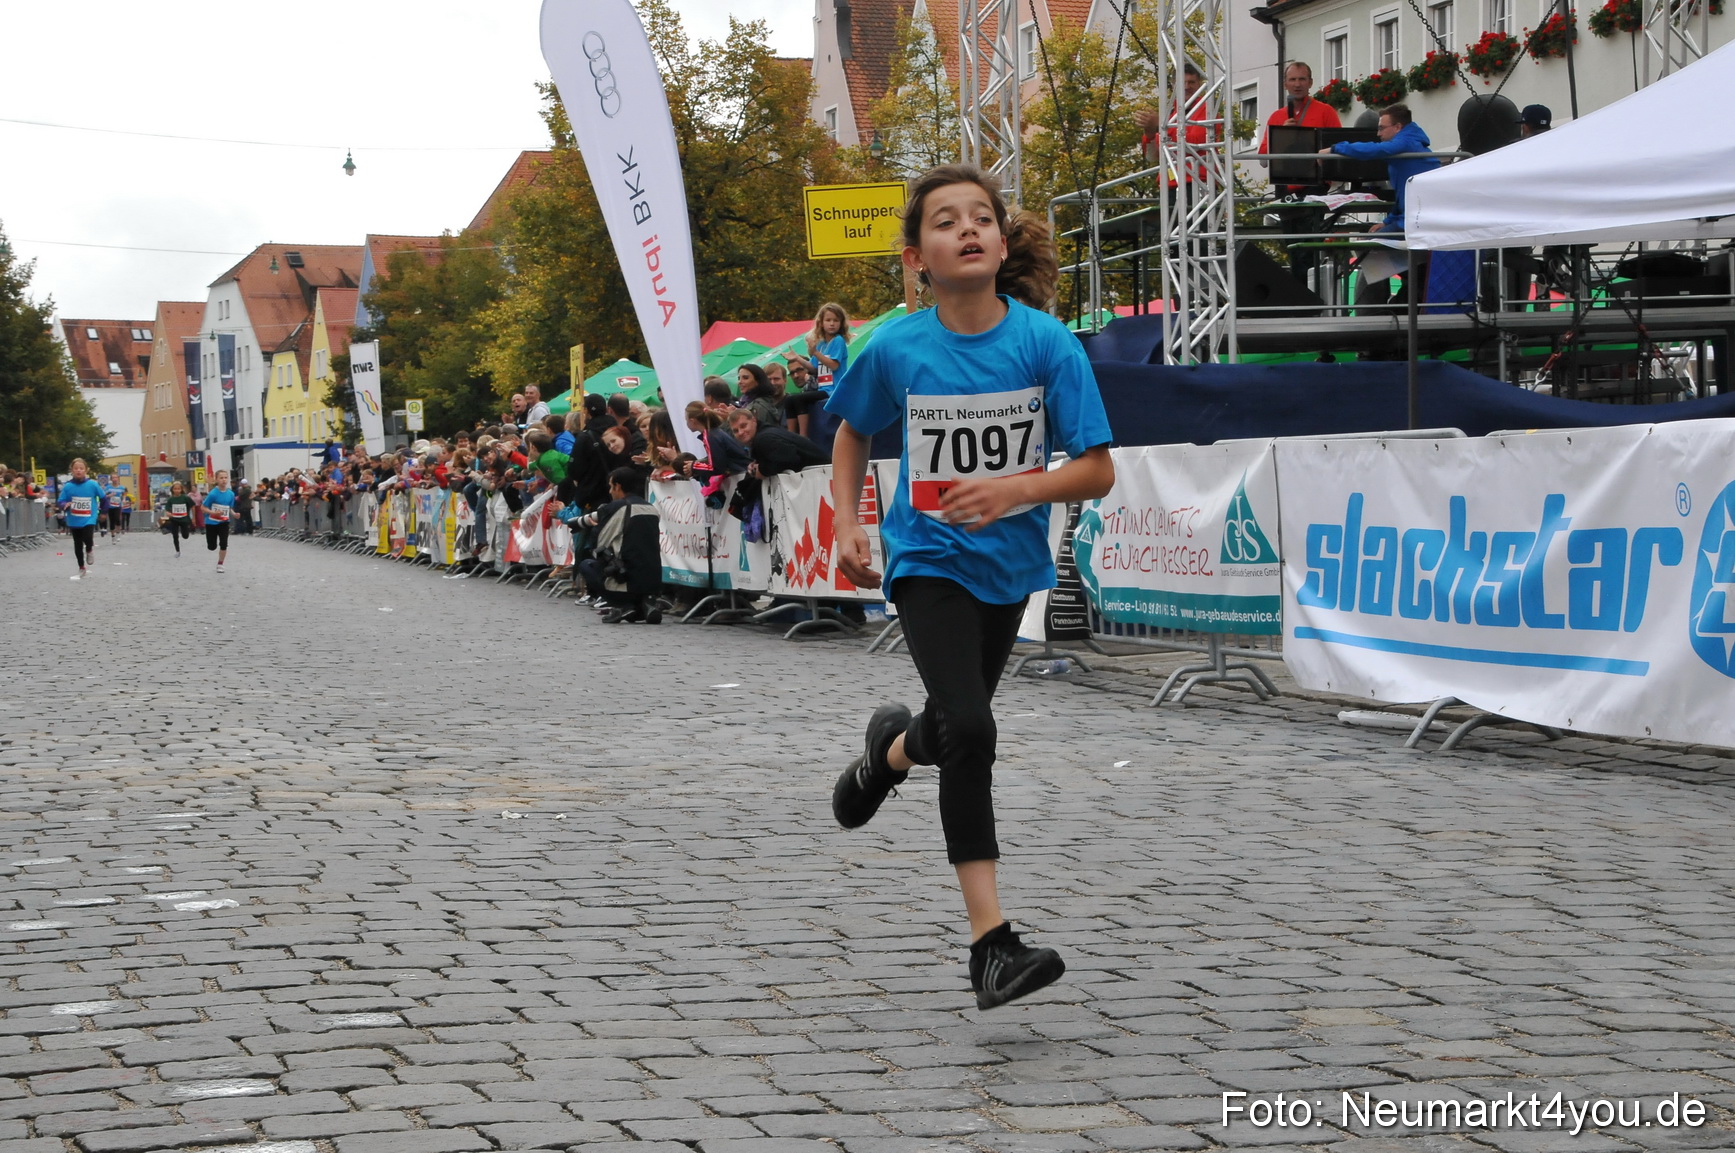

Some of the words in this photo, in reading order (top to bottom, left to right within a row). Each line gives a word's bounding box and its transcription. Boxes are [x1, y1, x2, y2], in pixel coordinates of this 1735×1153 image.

[813, 206, 895, 222] Schnupper
[844, 224, 872, 239] lauf
[910, 408, 954, 420] PARTL
[957, 404, 1023, 420] Neumarkt
[922, 420, 1034, 474] 7097
[915, 471, 921, 480] 5
[72, 501, 91, 510] 7065
[1296, 492, 1684, 633] slackstar
